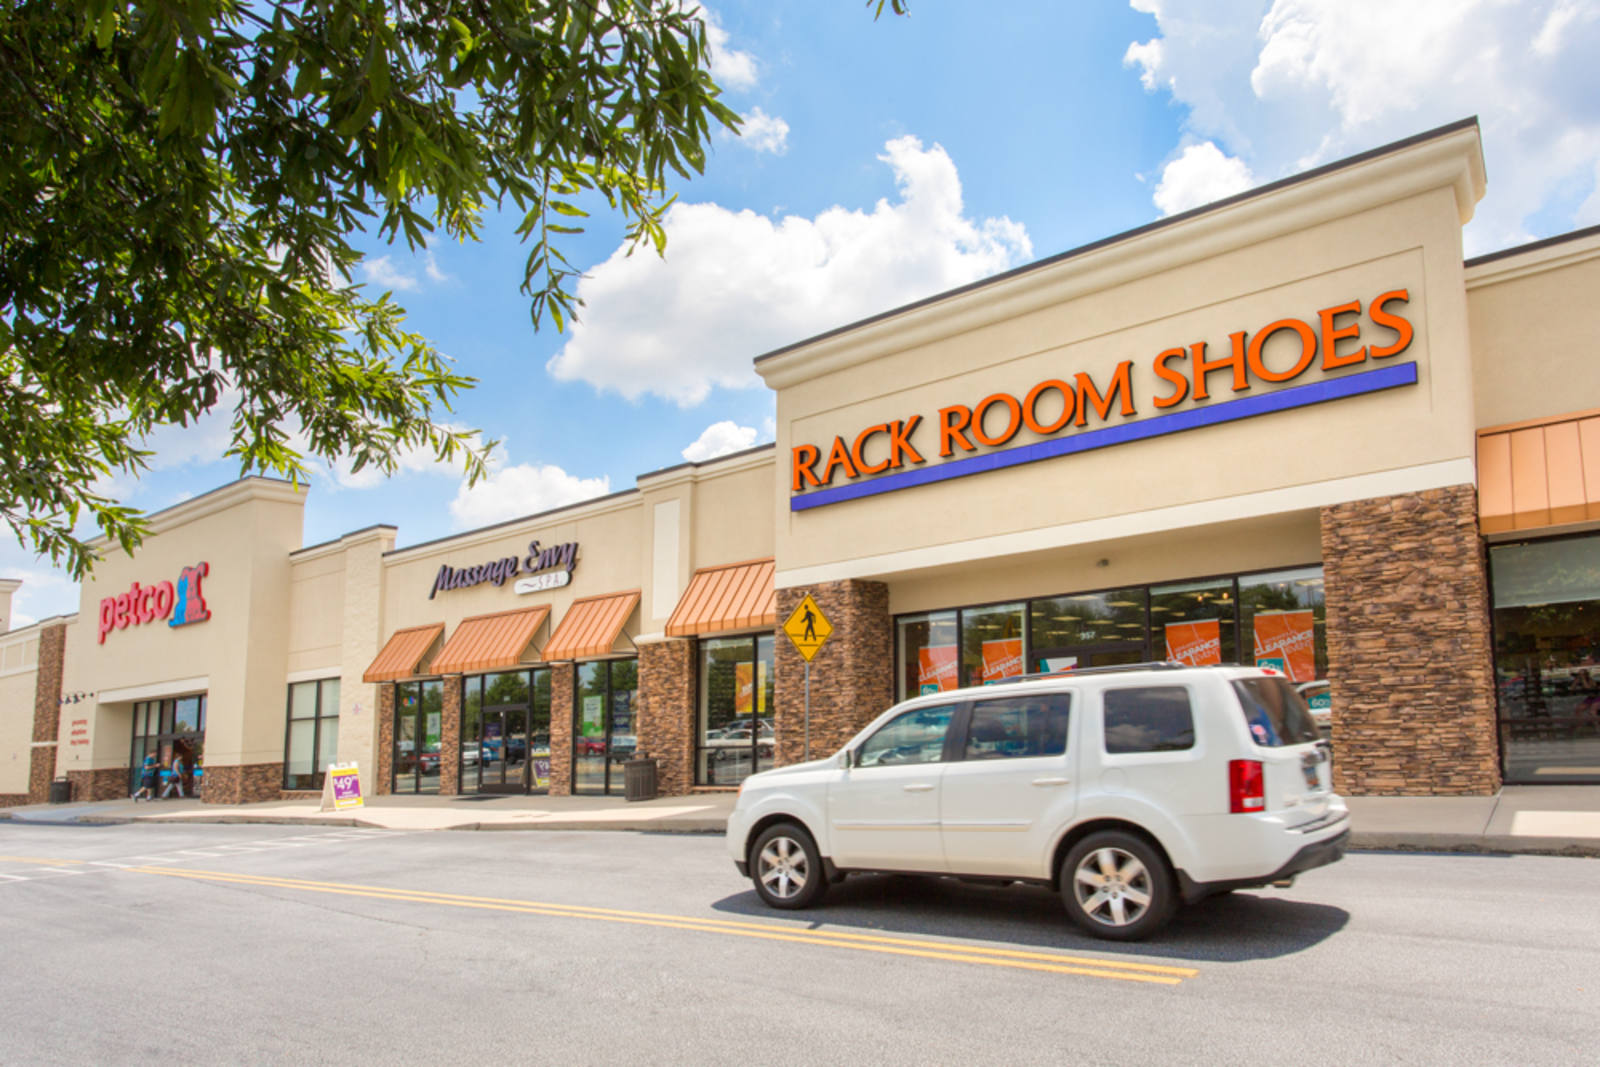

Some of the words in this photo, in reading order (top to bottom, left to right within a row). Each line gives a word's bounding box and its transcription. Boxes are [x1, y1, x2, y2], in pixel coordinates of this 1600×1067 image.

[790, 414, 925, 490] RACK
[938, 360, 1136, 458] ROOM
[1152, 288, 1415, 408] SHOES
[428, 555, 519, 600] Massage
[521, 540, 580, 573] Envy
[538, 573, 560, 589] SPA
[97, 580, 175, 646] petco
